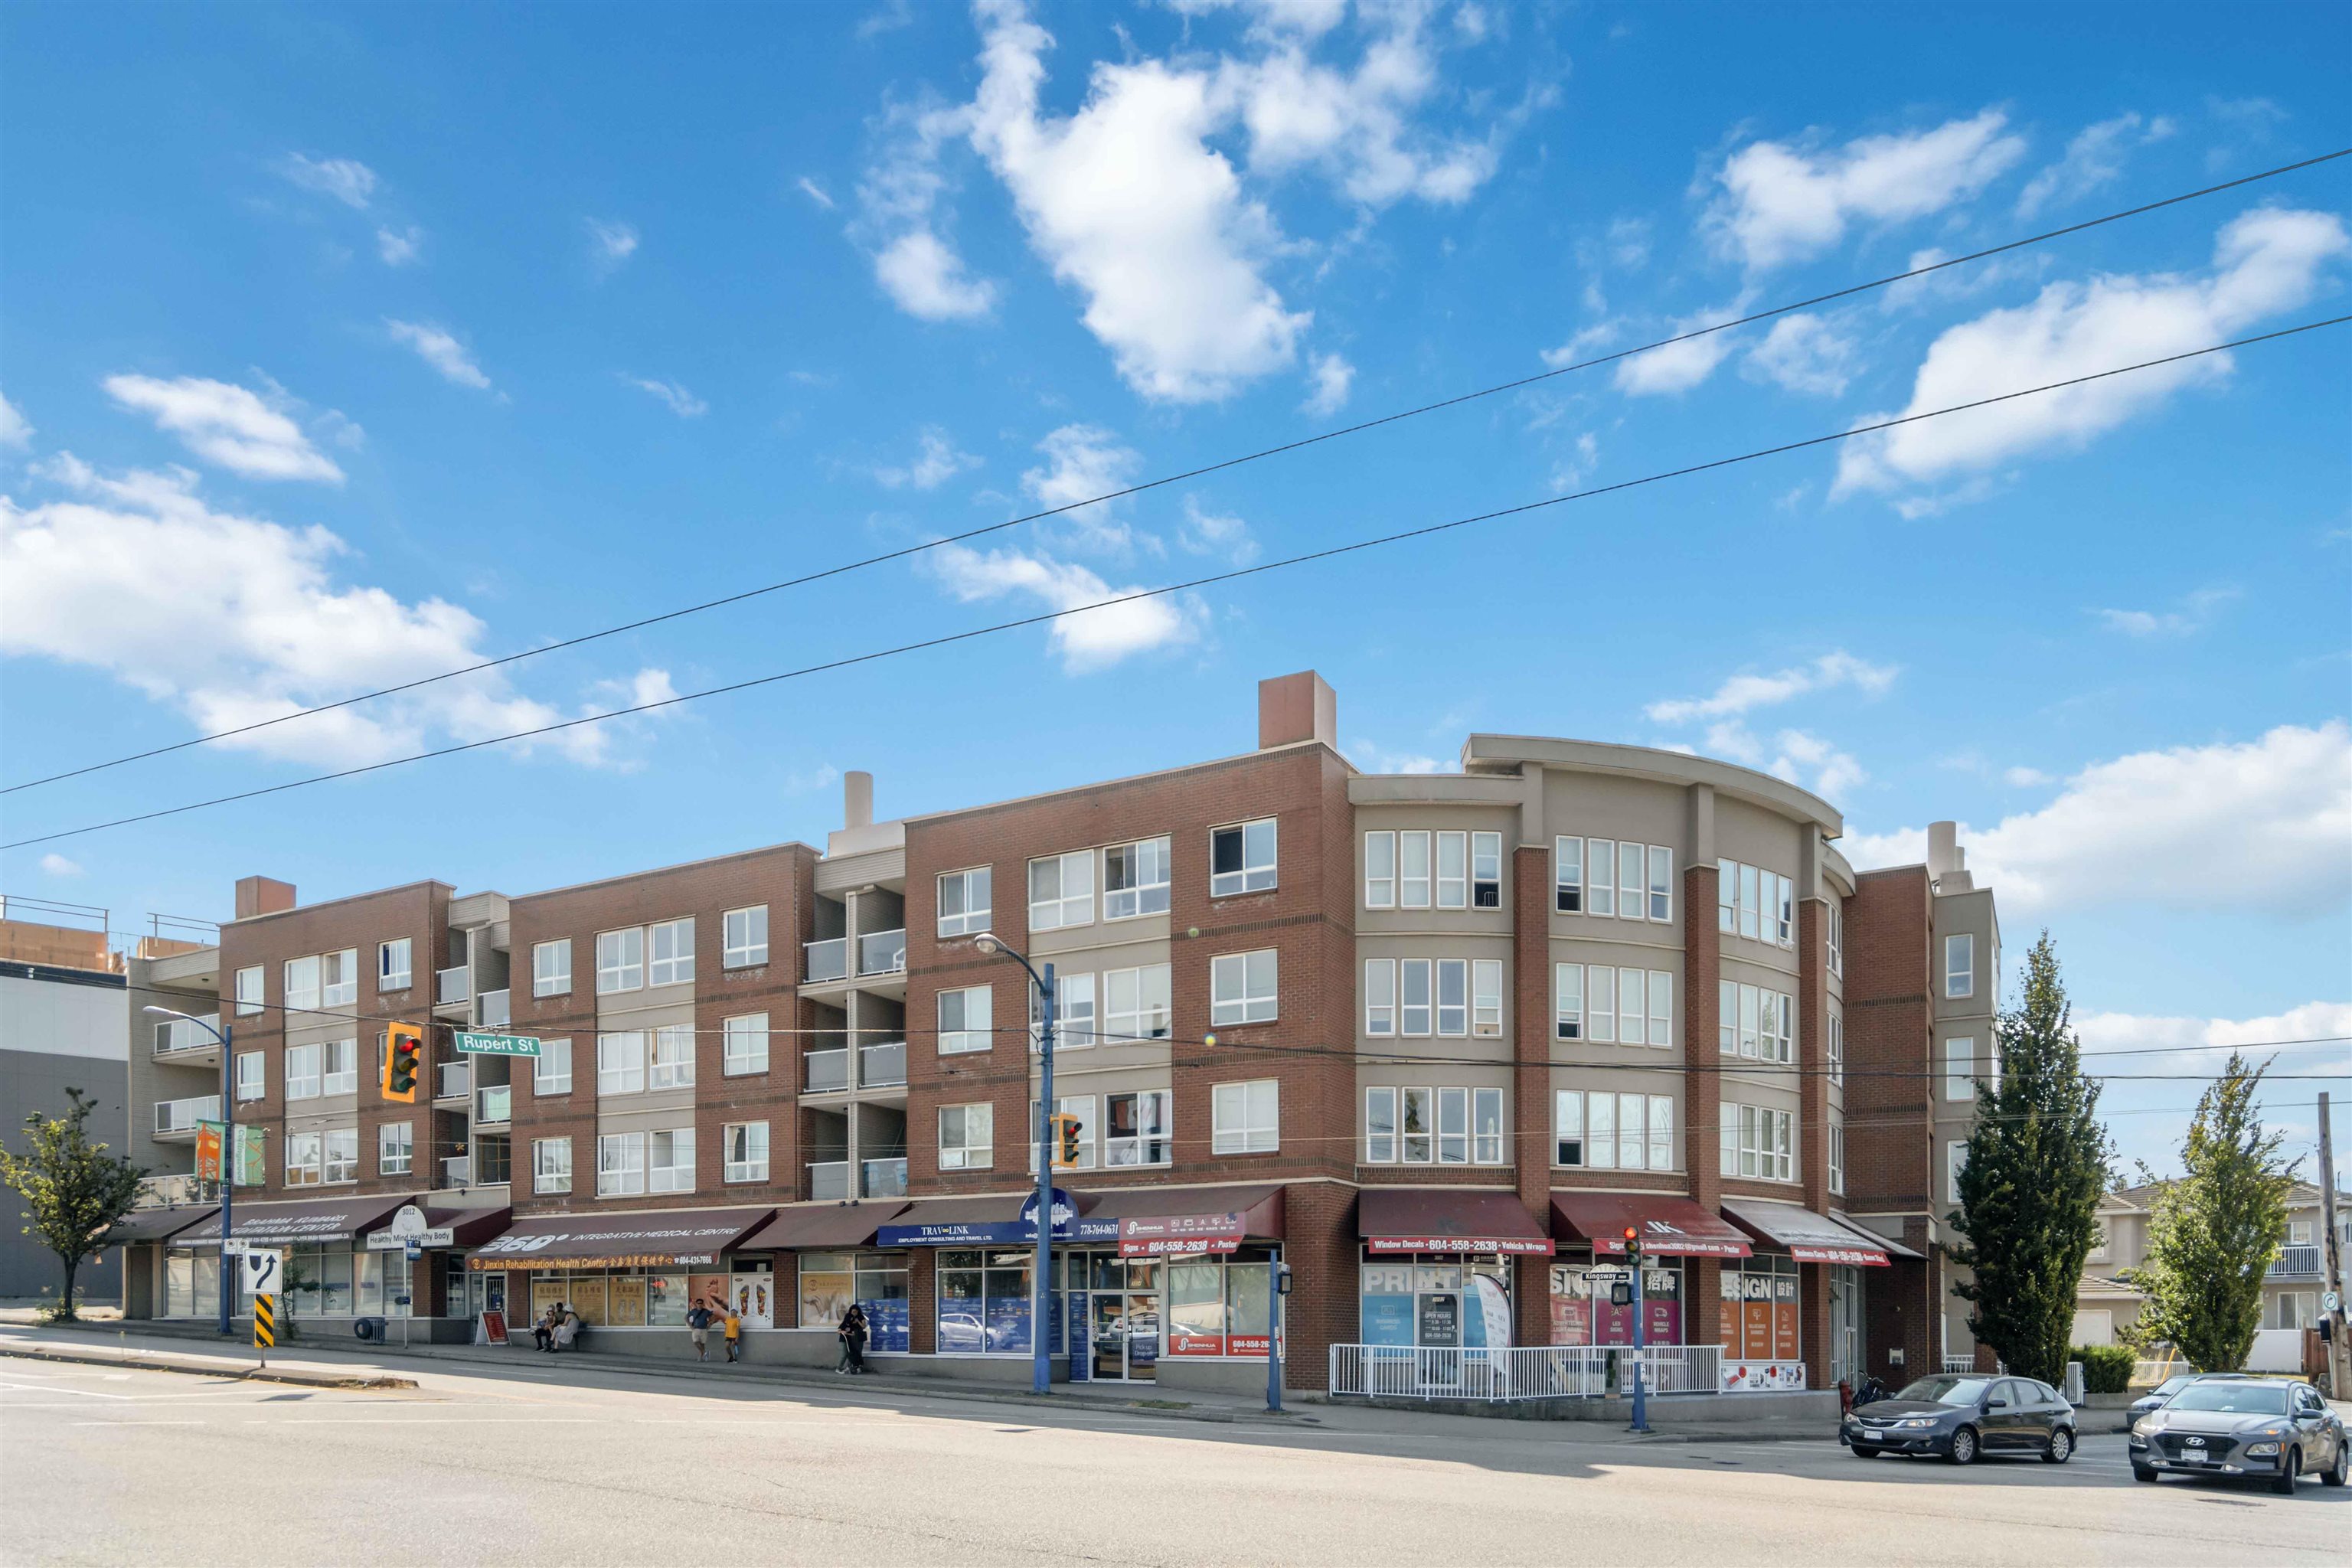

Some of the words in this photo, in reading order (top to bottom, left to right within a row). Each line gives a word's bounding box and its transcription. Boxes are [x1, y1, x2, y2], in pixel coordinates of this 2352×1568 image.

[463, 1034, 513, 1051] Rupert
[518, 1038, 534, 1052] St
[402, 1207, 415, 1216] 3012
[292, 1223, 341, 1233] CENTER
[570, 1231, 643, 1241] INTEGRATIVE
[642, 1229, 692, 1238] MEDICAL
[694, 1227, 741, 1236] CENTRE
[1080, 1224, 1119, 1235] 778-764-0631
[370, 1235, 392, 1244] Healthy
[394, 1233, 409, 1242] Mind
[410, 1232, 433, 1241] Healthy
[434, 1231, 450, 1240] Body
[1124, 1243, 1138, 1253] Signs
[1148, 1240, 1207, 1252] 604-558-2638
[1217, 1240, 1237, 1249] Poster
[1374, 1240, 1402, 1249] Window
[1403, 1240, 1424, 1248] Decals
[1429, 1240, 1498, 1250] 604-558-2638
[1502, 1241, 1524, 1250] Vehicle
[1525, 1242, 1547, 1252] Wraps
[1609, 1242, 1625, 1250] Sign
[483, 1260, 505, 1269] Jinxin
[505, 1259, 554, 1269] Rehabilitation
[556, 1259, 580, 1268] Health
[581, 1258, 607, 1268] Center
[679, 1255, 713, 1265] 604-431-7666
[1364, 1271, 1456, 1292] PRINT
[1647, 1275, 1675, 1292] 招牌
[1777, 1281, 1795, 1297] 設計
